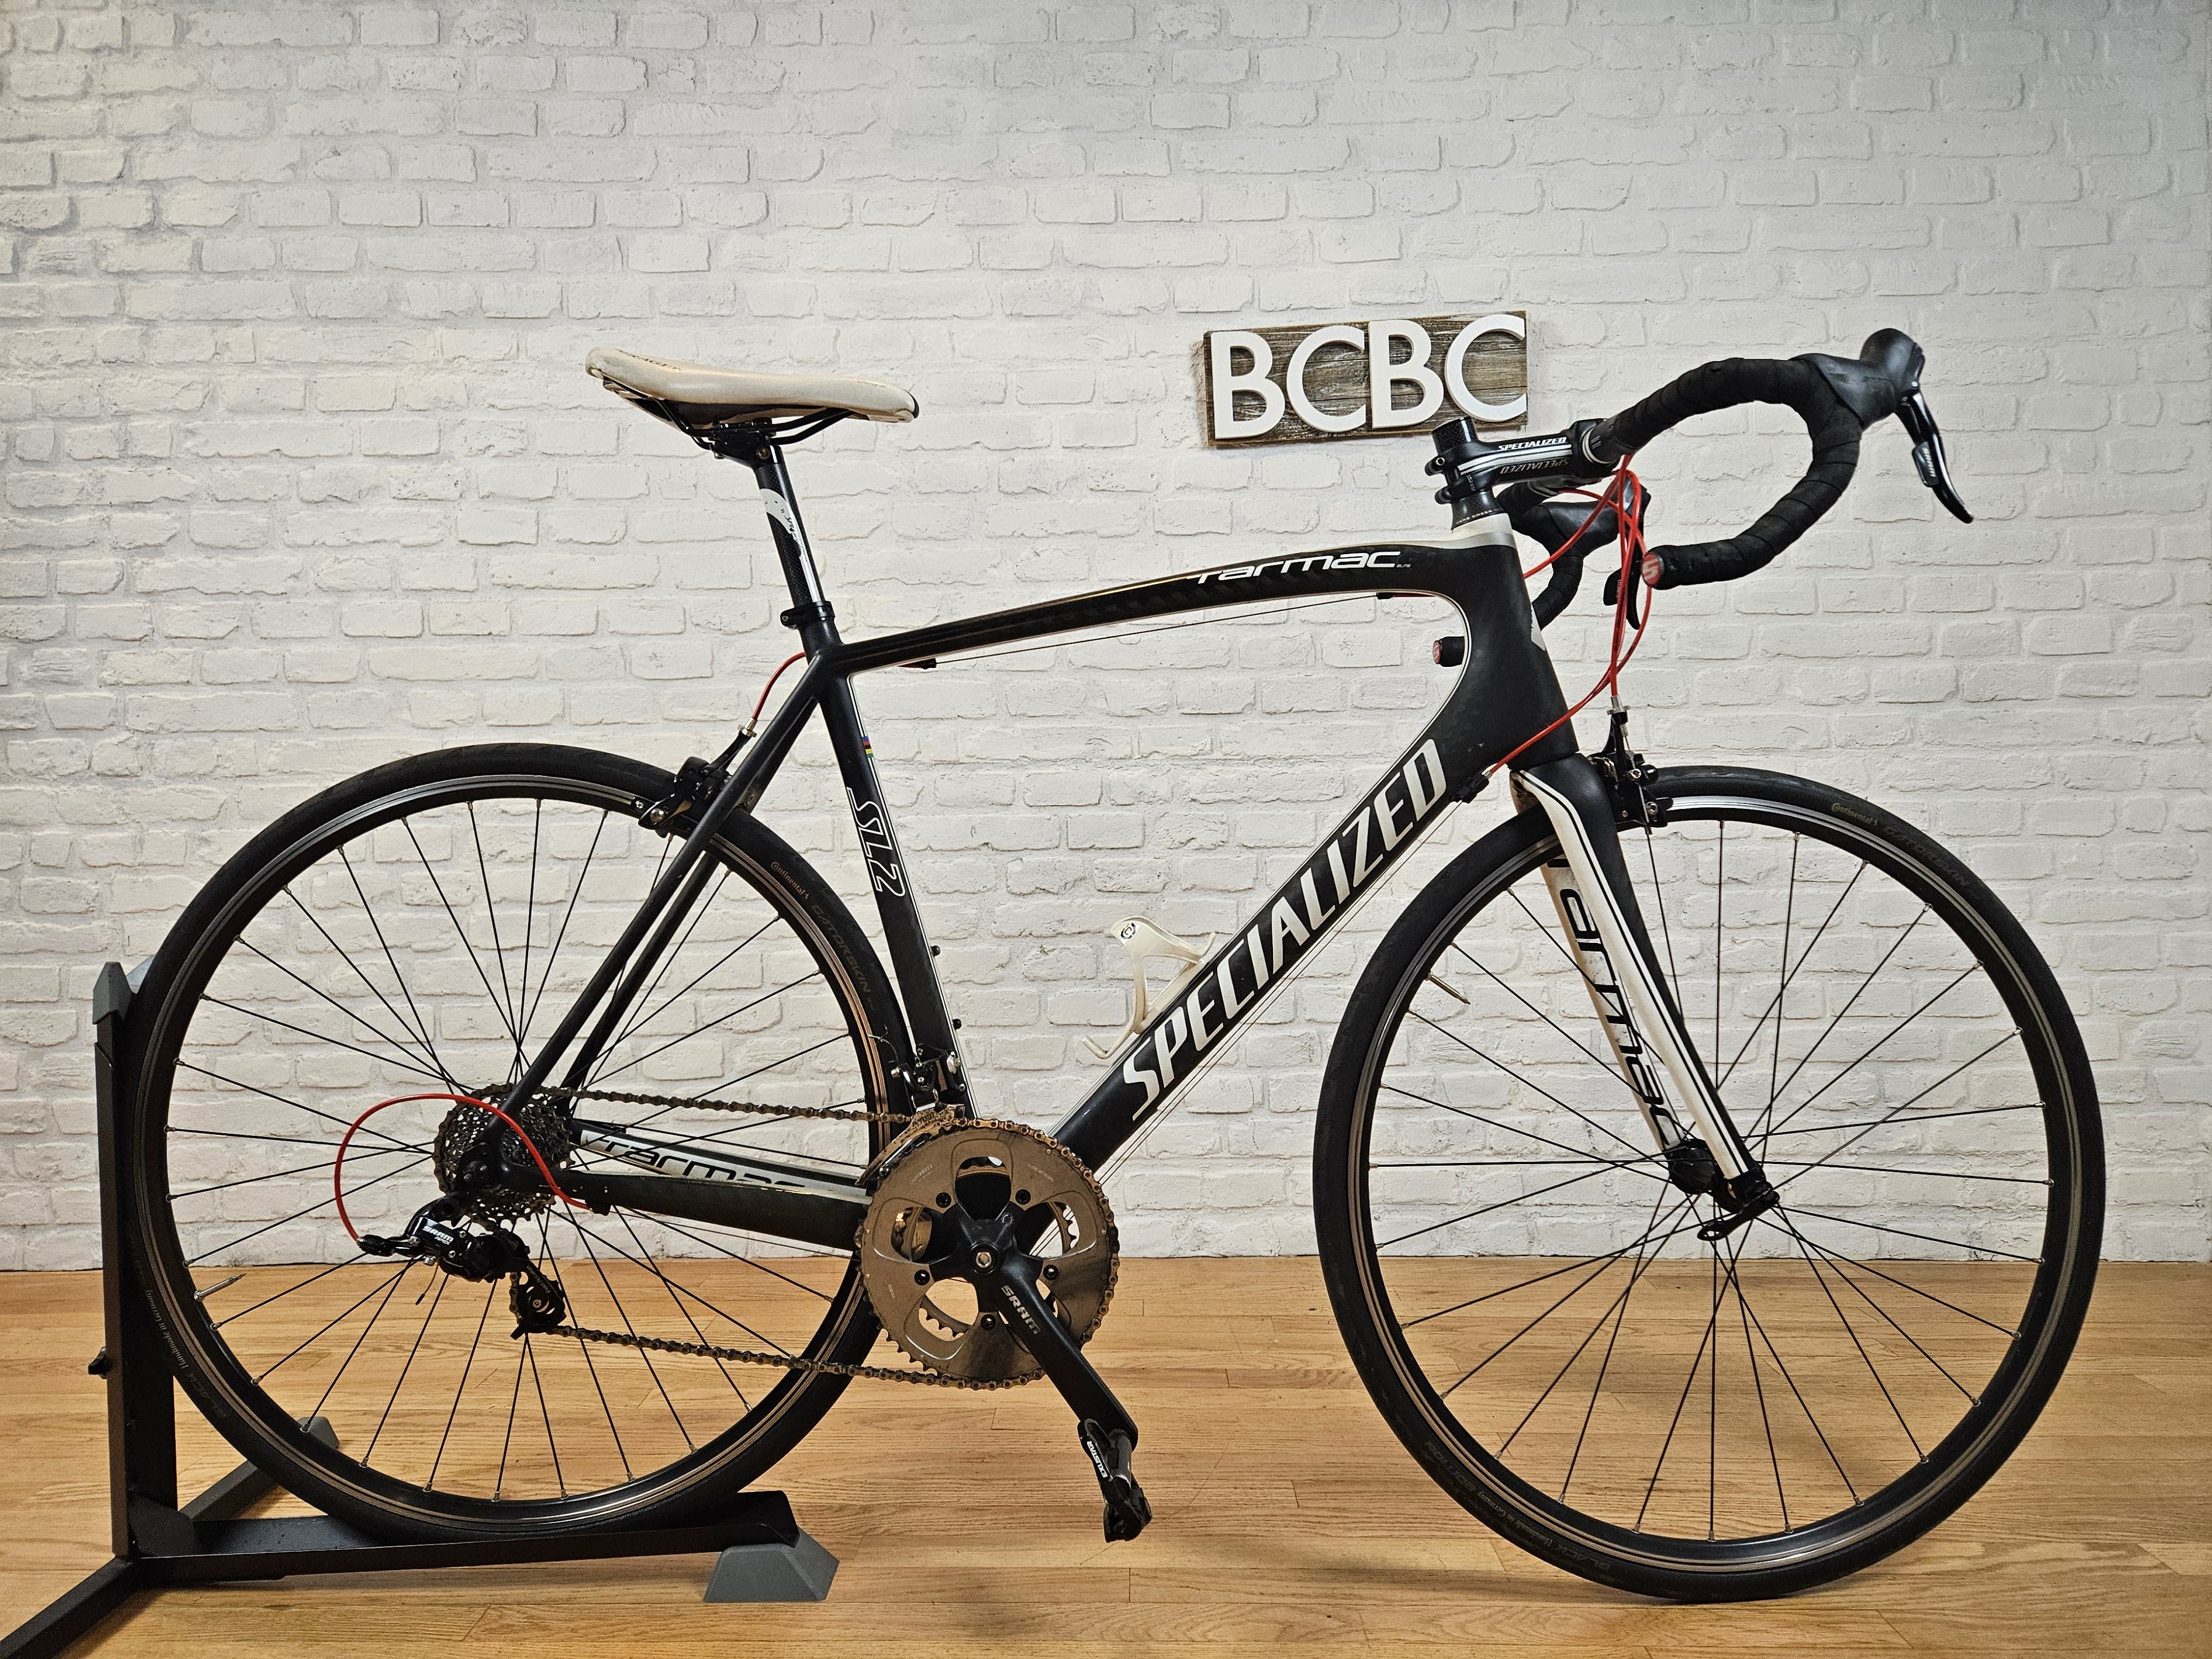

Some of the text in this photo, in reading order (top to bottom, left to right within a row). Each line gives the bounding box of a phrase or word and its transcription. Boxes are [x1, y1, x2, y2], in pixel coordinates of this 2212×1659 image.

[1211, 314, 1527, 440] BCBC
[1498, 436, 1567, 452] SPECIALIZED
[1500, 457, 1569, 474] SPECIALIZED
[1831, 803, 1874, 825] Continental
[846, 786, 906, 897] SL2
[771, 861, 806, 896] Continental
[1123, 738, 1447, 1121] SPECIALIZED
[422, 1225, 454, 1243] SRAM
[1000, 1285, 1041, 1335] SRAM
